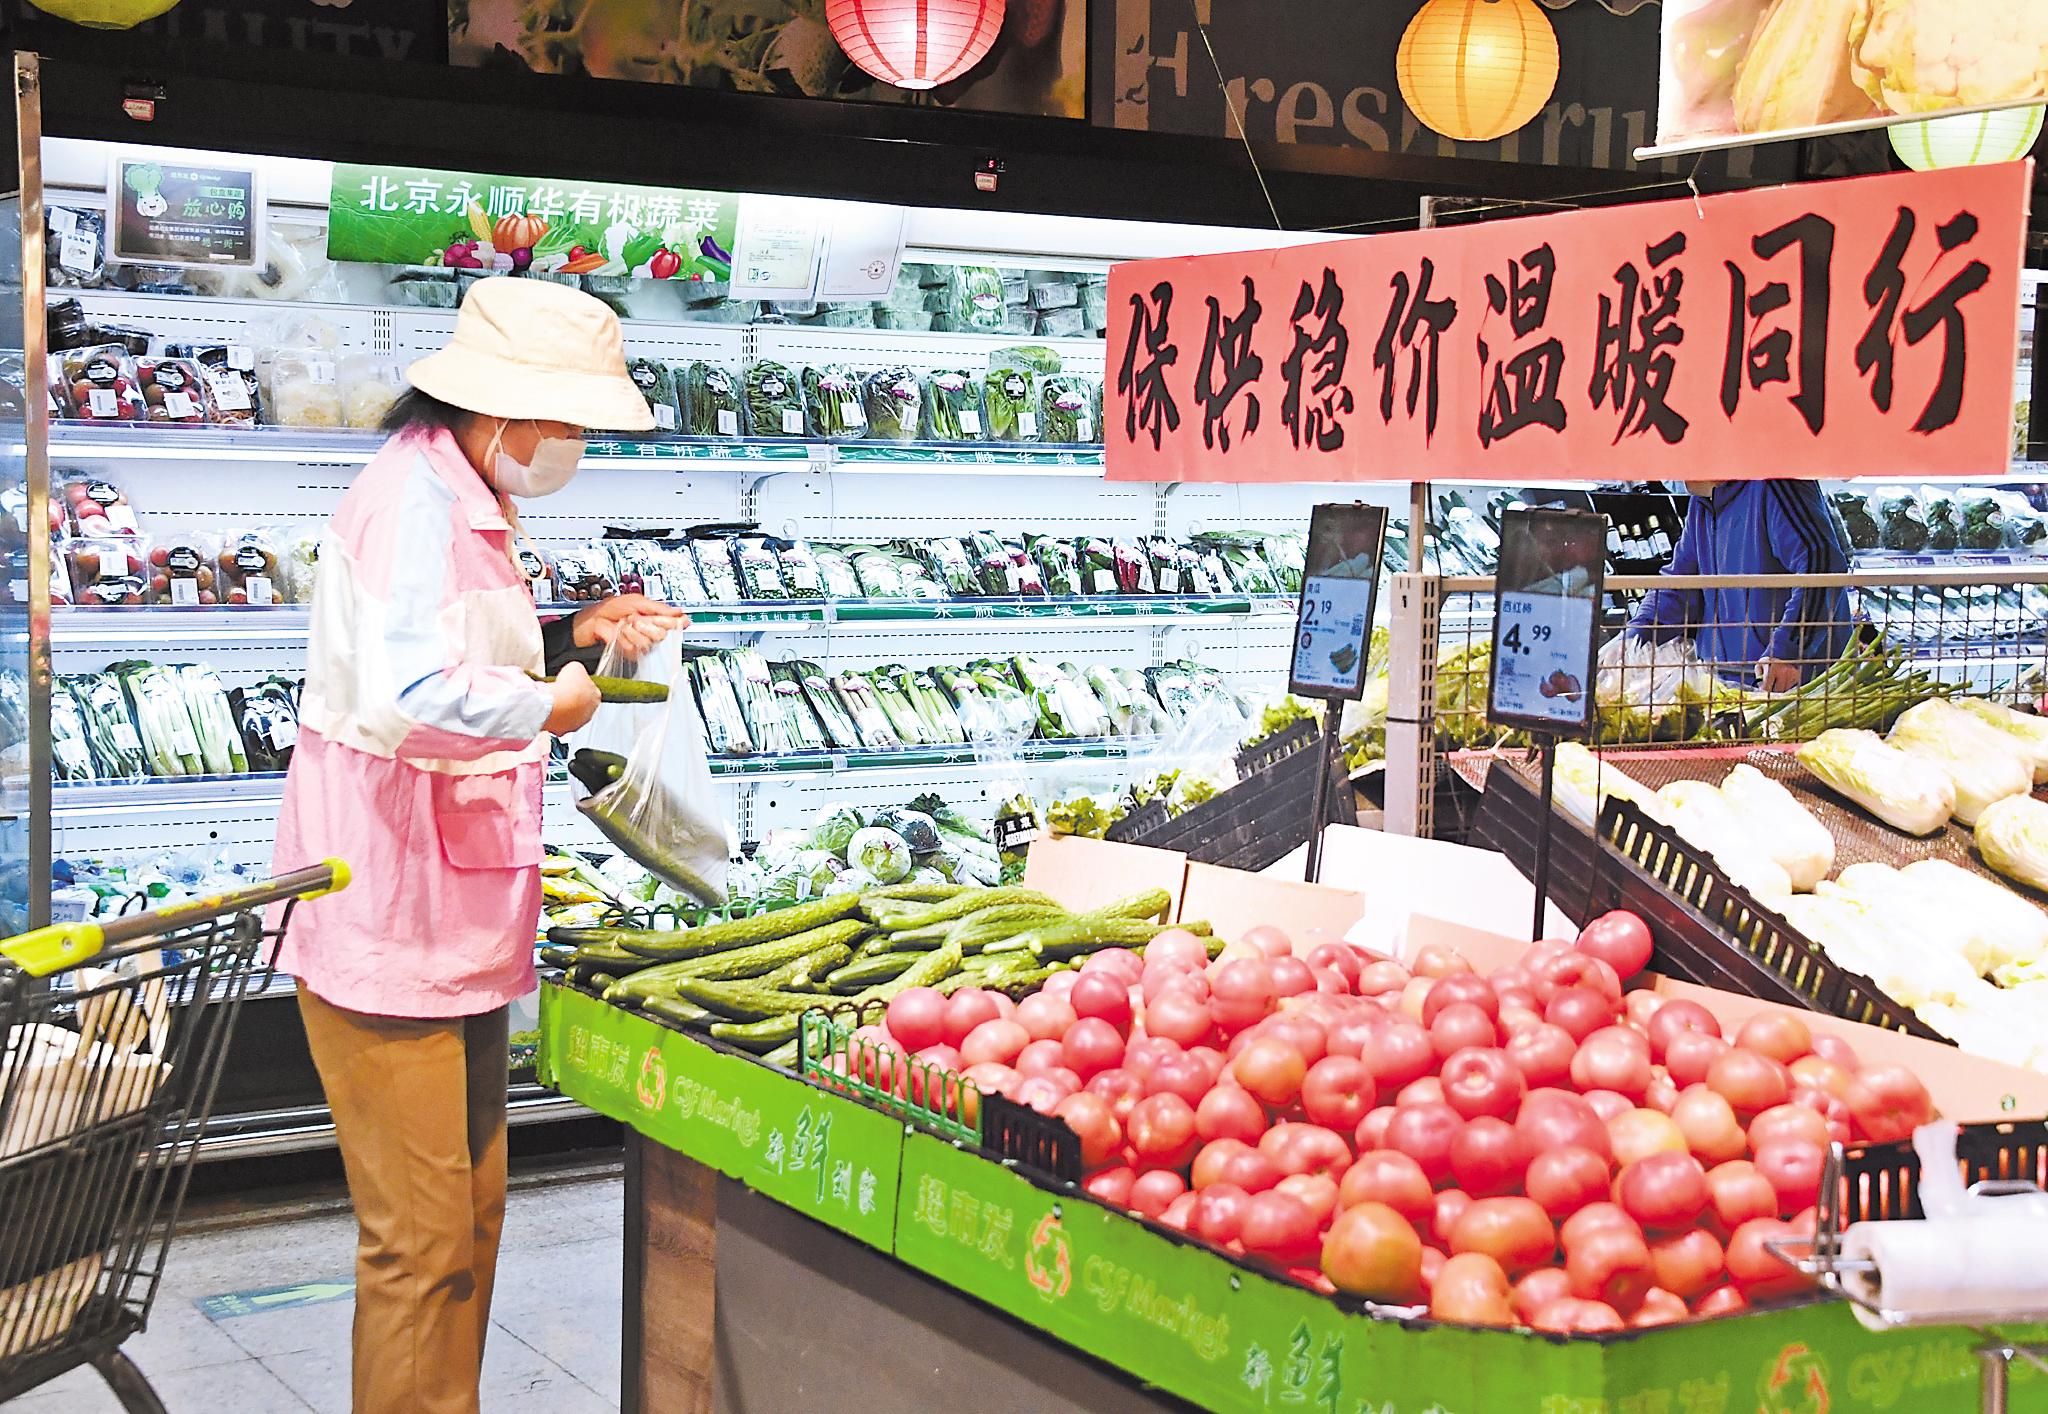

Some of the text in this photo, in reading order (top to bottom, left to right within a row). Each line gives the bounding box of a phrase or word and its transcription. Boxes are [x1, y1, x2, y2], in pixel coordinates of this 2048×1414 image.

[1115, 0, 1456, 157] Fres
[182, 198, 246, 221] 放心购
[359, 174, 721, 232] 北京永顺华有机蔬菜
[1118, 206, 1992, 455] 保供稳价温暖同行
[934, 602, 1192, 619] 永顺华绿色蔬菜
[1503, 601, 1532, 613] 西红柿
[1502, 623, 1552, 655] 4.99
[914, 1173, 1015, 1270] 超市发
